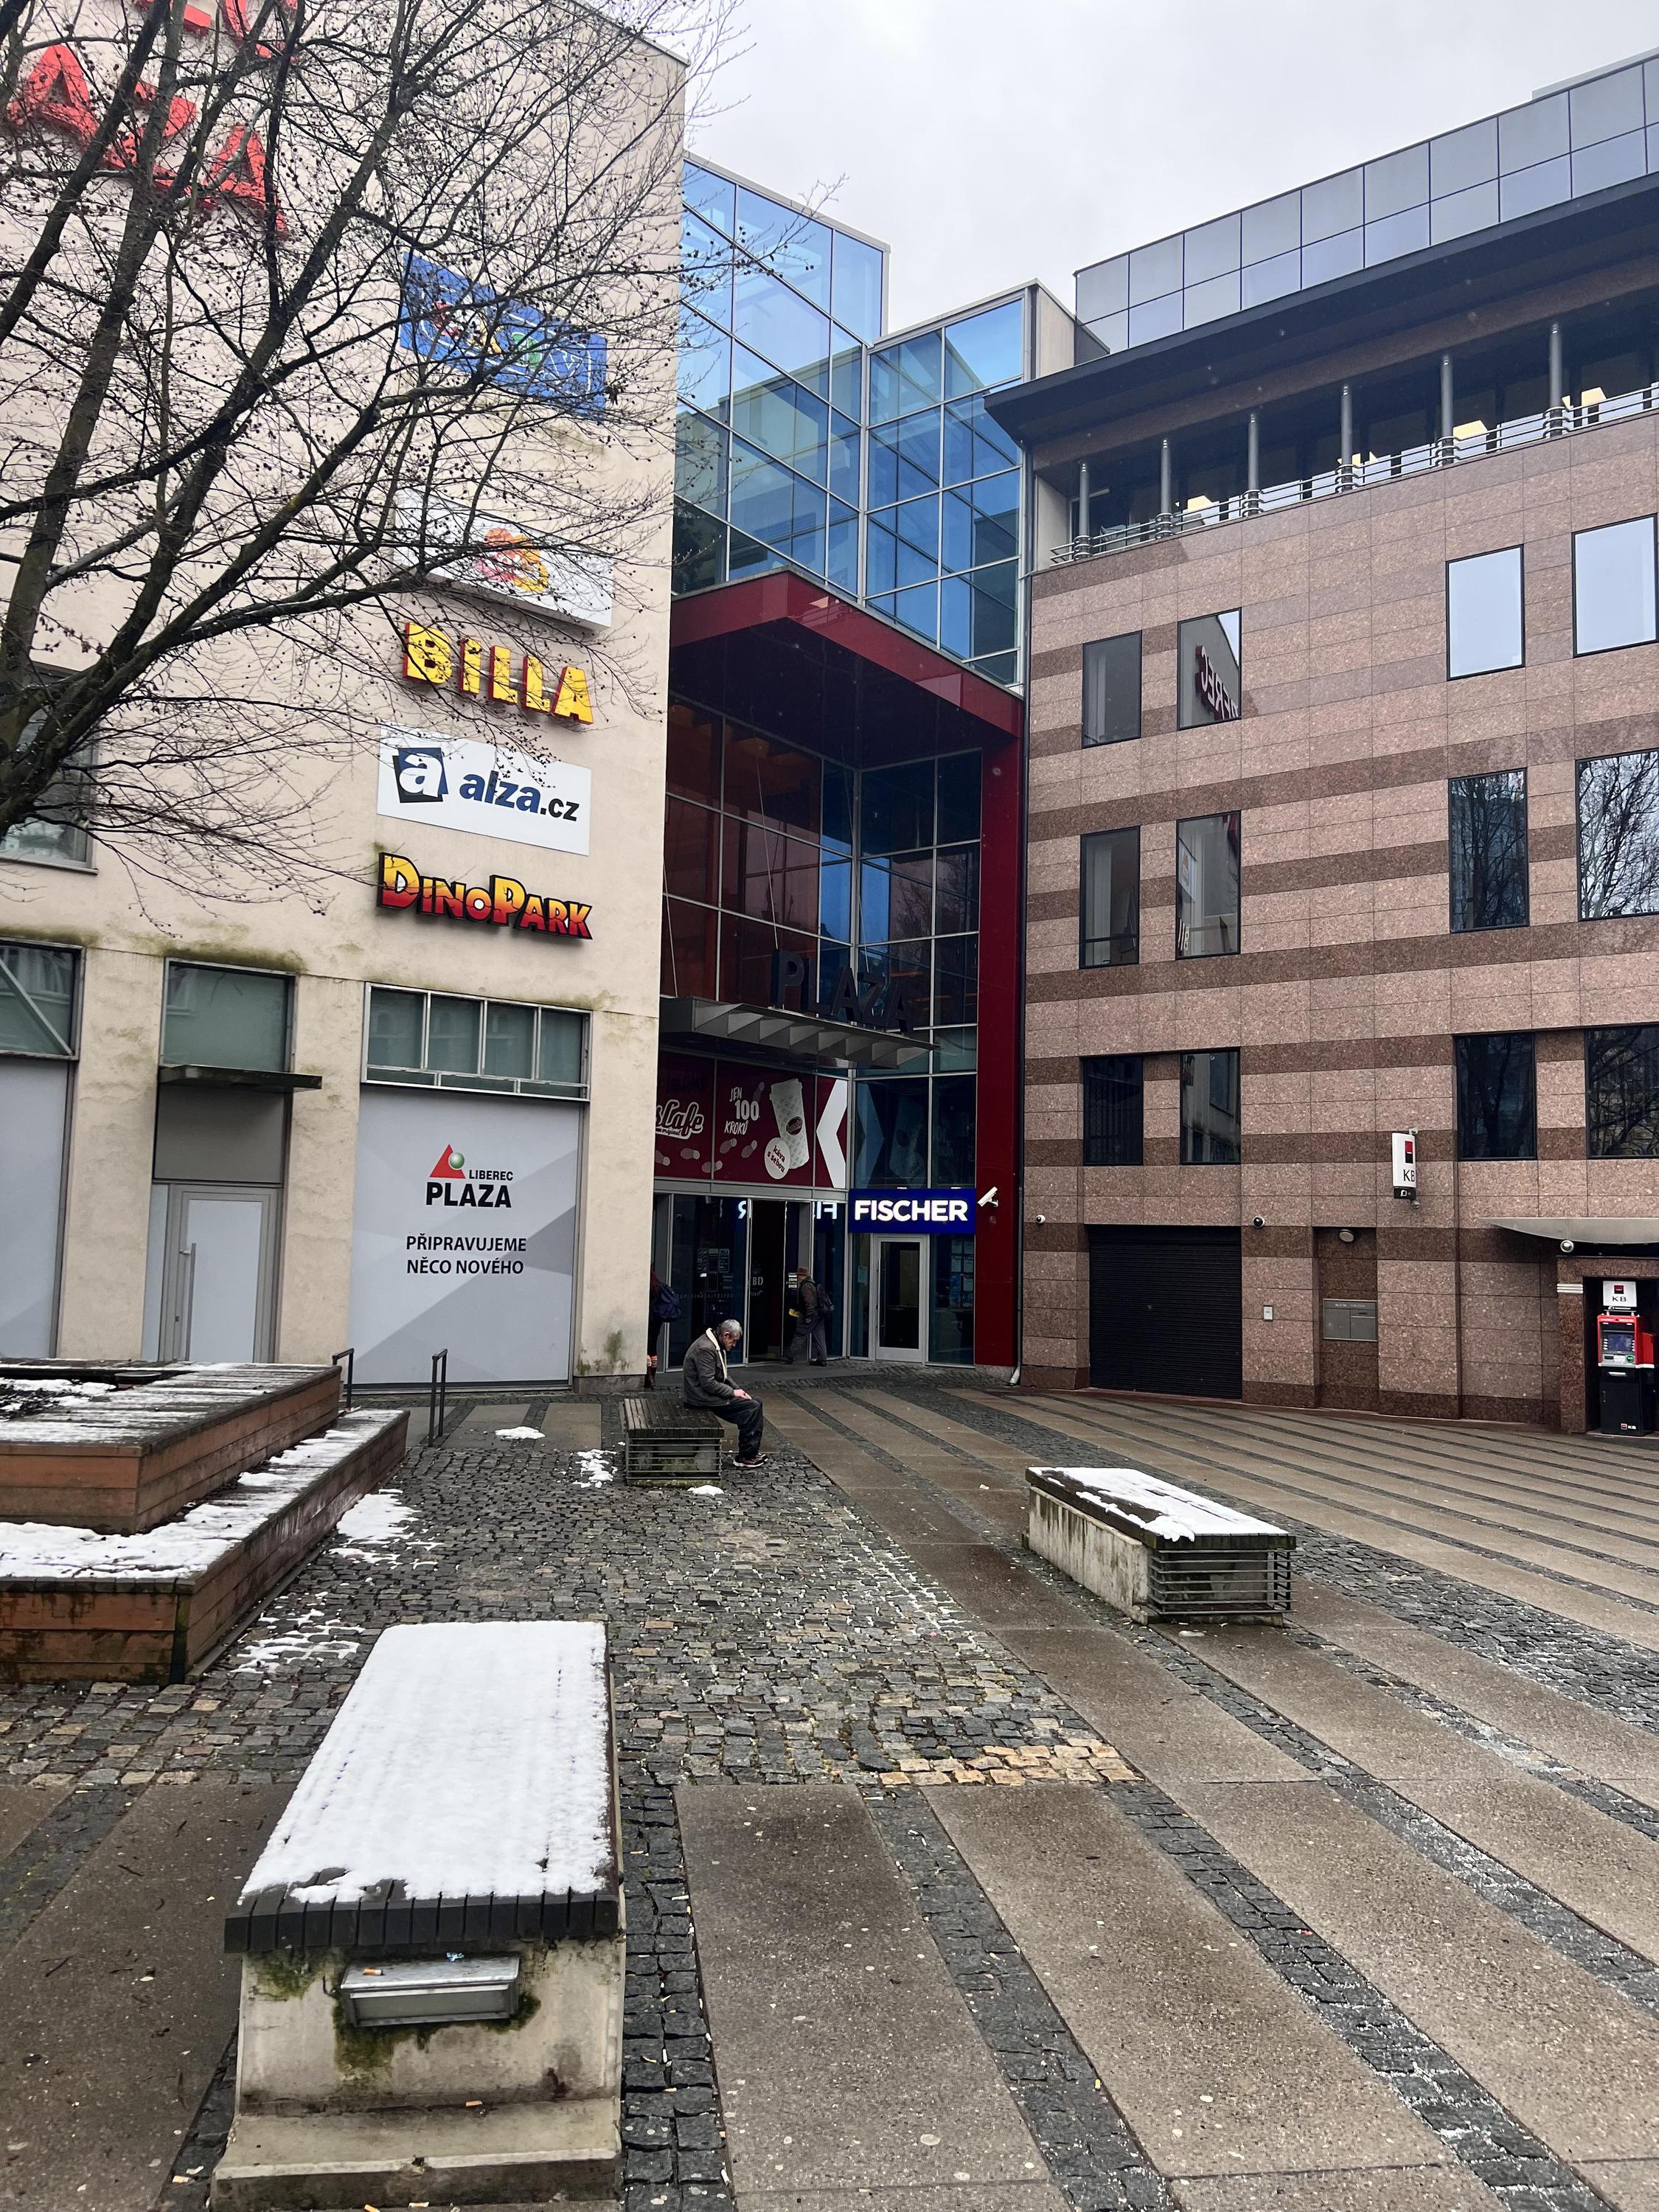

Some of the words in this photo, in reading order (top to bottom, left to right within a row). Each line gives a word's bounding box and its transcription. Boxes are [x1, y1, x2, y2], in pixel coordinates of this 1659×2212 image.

[403, 622, 594, 724] BILLA
[459, 770, 580, 822] alza.cz
[771, 949, 915, 1032] PLAZA
[729, 1086, 742, 1102] JEN
[734, 1099, 759, 1121] 100
[469, 1169, 514, 1181] LIBEREC
[1403, 1169, 1415, 1182] KB
[425, 1181, 512, 1208] PLAZA
[855, 1200, 968, 1222] FISCHER
[406, 1233, 526, 1251] PŘIPRAVUJEME
[407, 1256, 451, 1274] NĚCO
[456, 1257, 524, 1275] NOVÉHO
